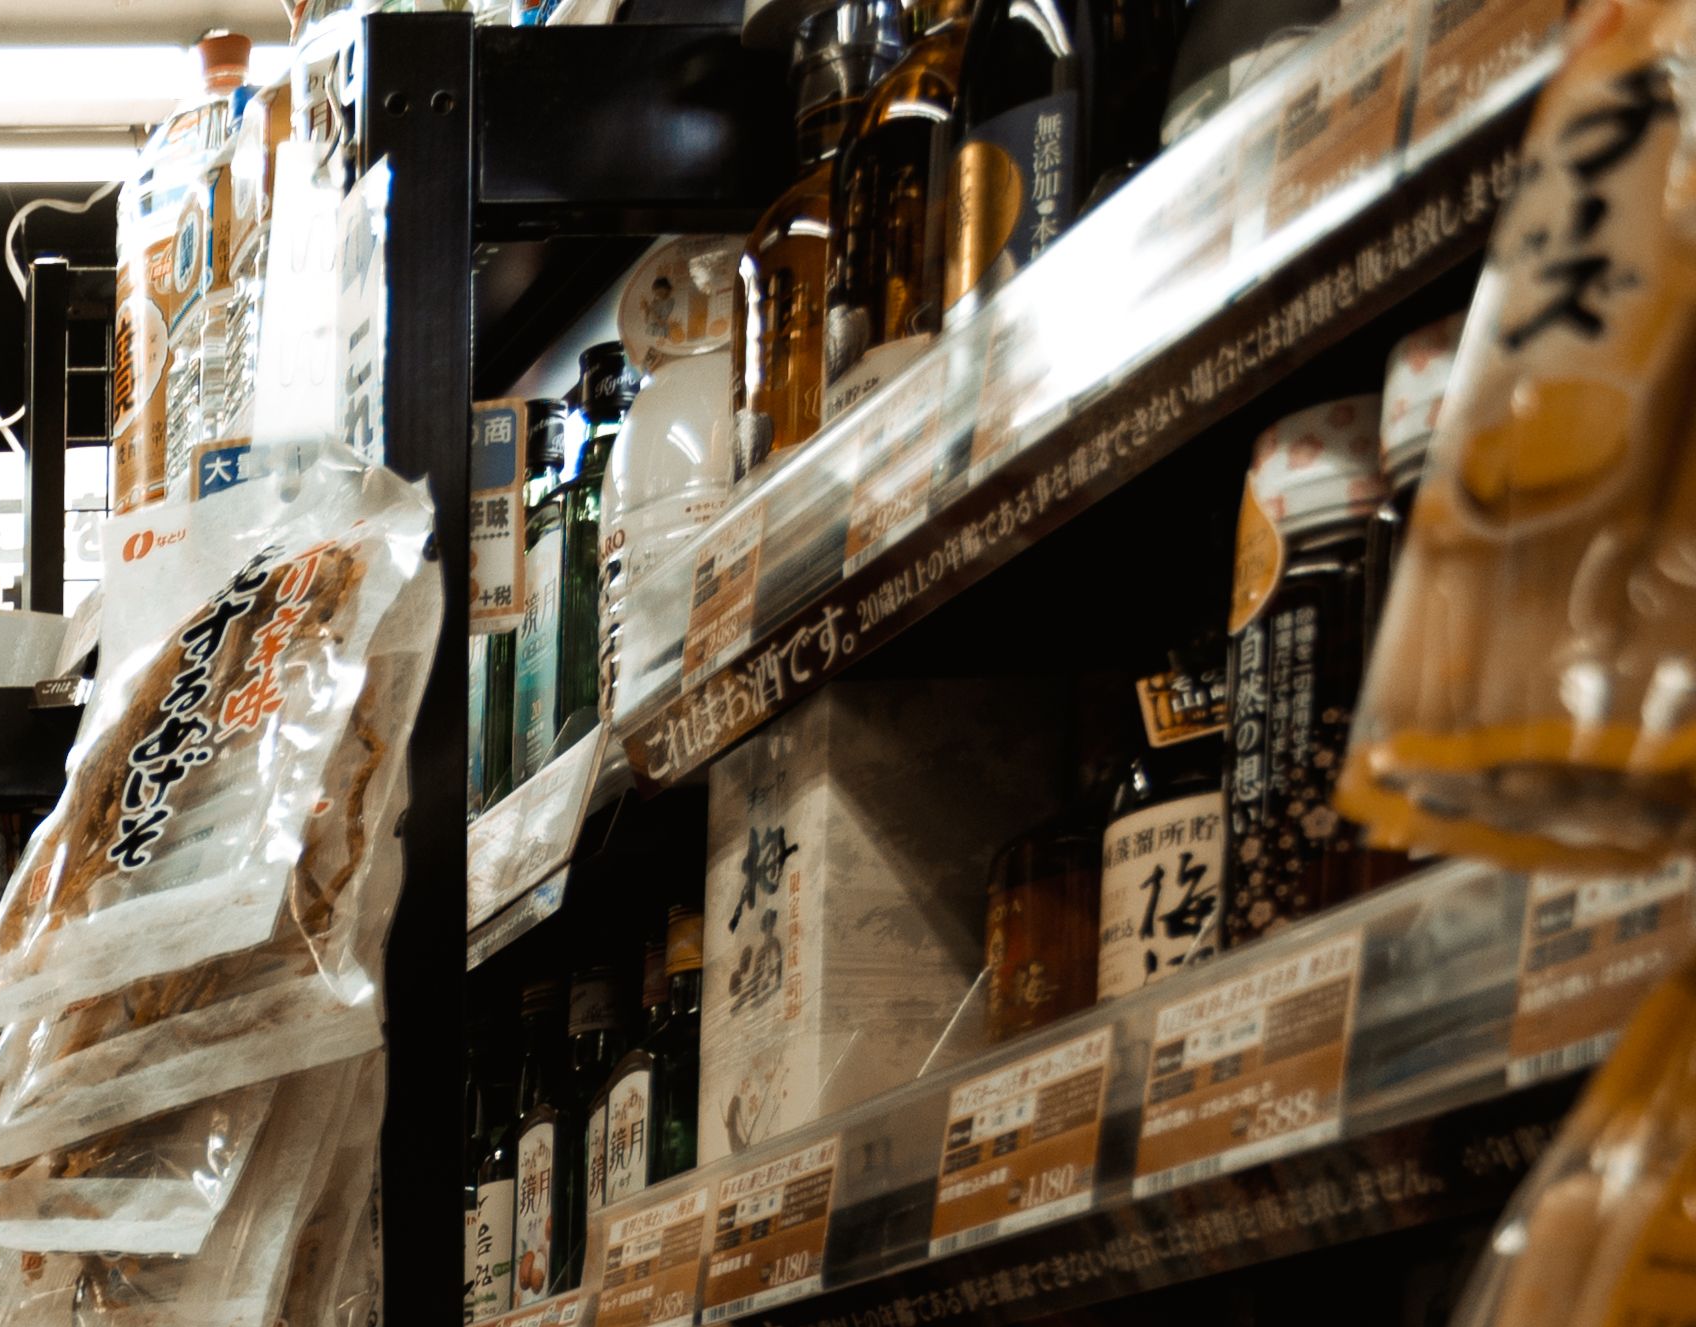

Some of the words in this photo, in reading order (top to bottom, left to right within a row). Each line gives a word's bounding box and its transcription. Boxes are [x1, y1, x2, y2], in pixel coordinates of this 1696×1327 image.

[156, 530, 186, 547] なとり
[645, 606, 858, 779] これはお酒です。
